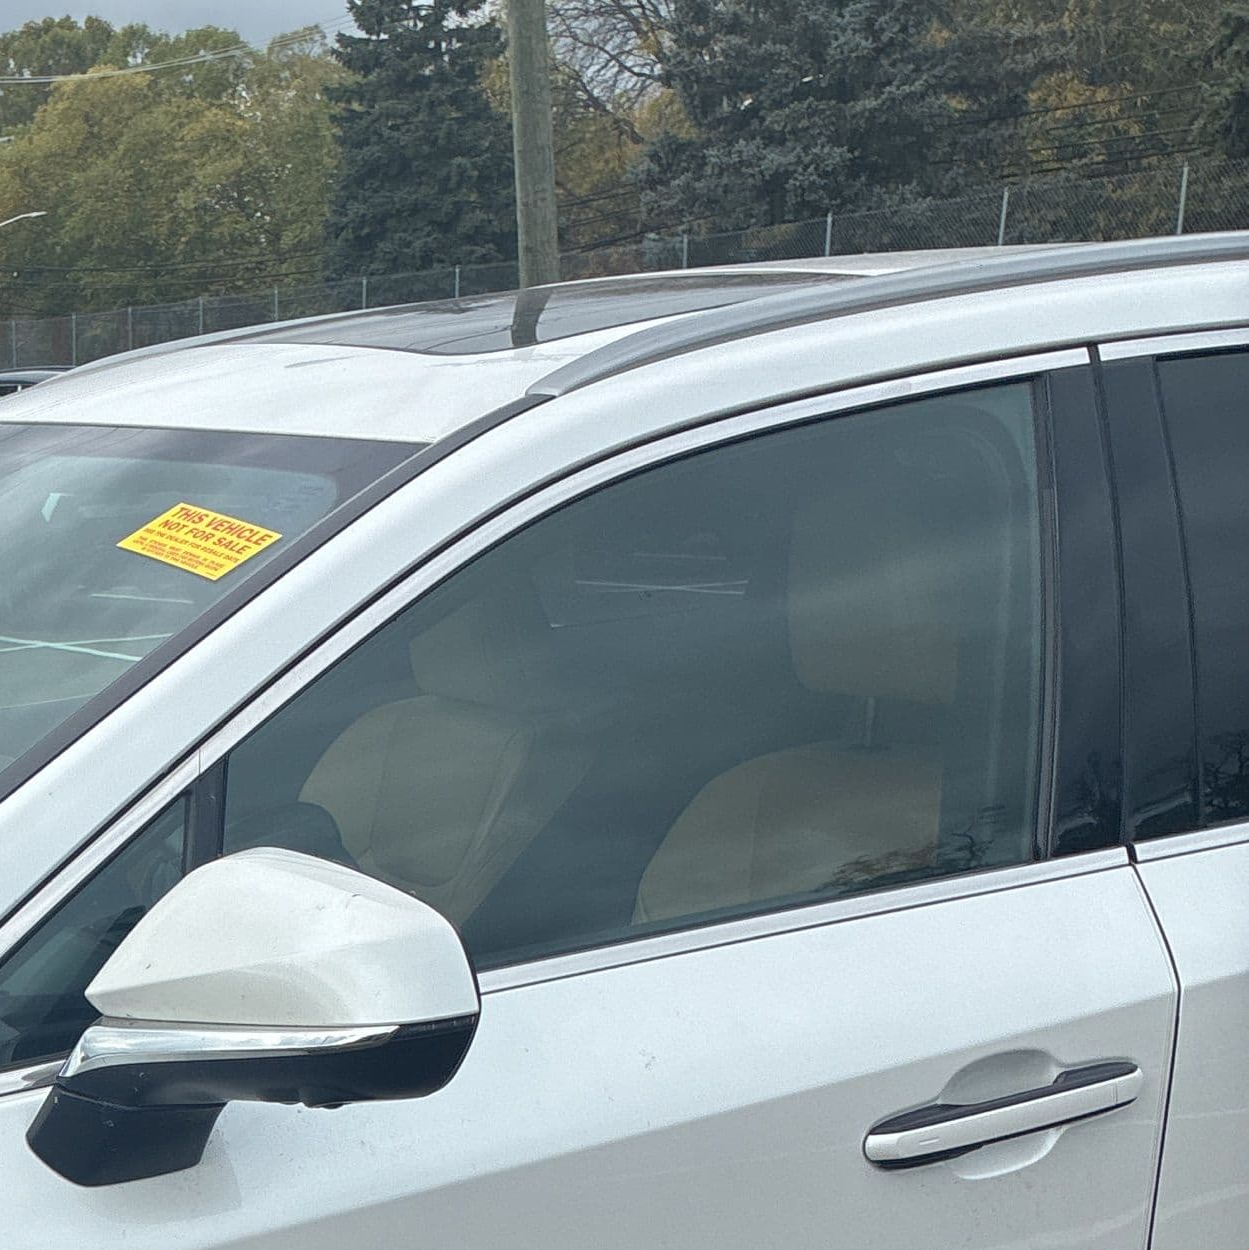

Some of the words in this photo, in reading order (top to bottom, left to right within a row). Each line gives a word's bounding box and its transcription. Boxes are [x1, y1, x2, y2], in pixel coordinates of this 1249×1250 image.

[158, 519, 189, 532] NOT
[184, 527, 216, 542] FOR
[211, 536, 252, 555] SALE
[171, 507, 209, 524] THIS
[206, 517, 273, 546] VEHICLE
